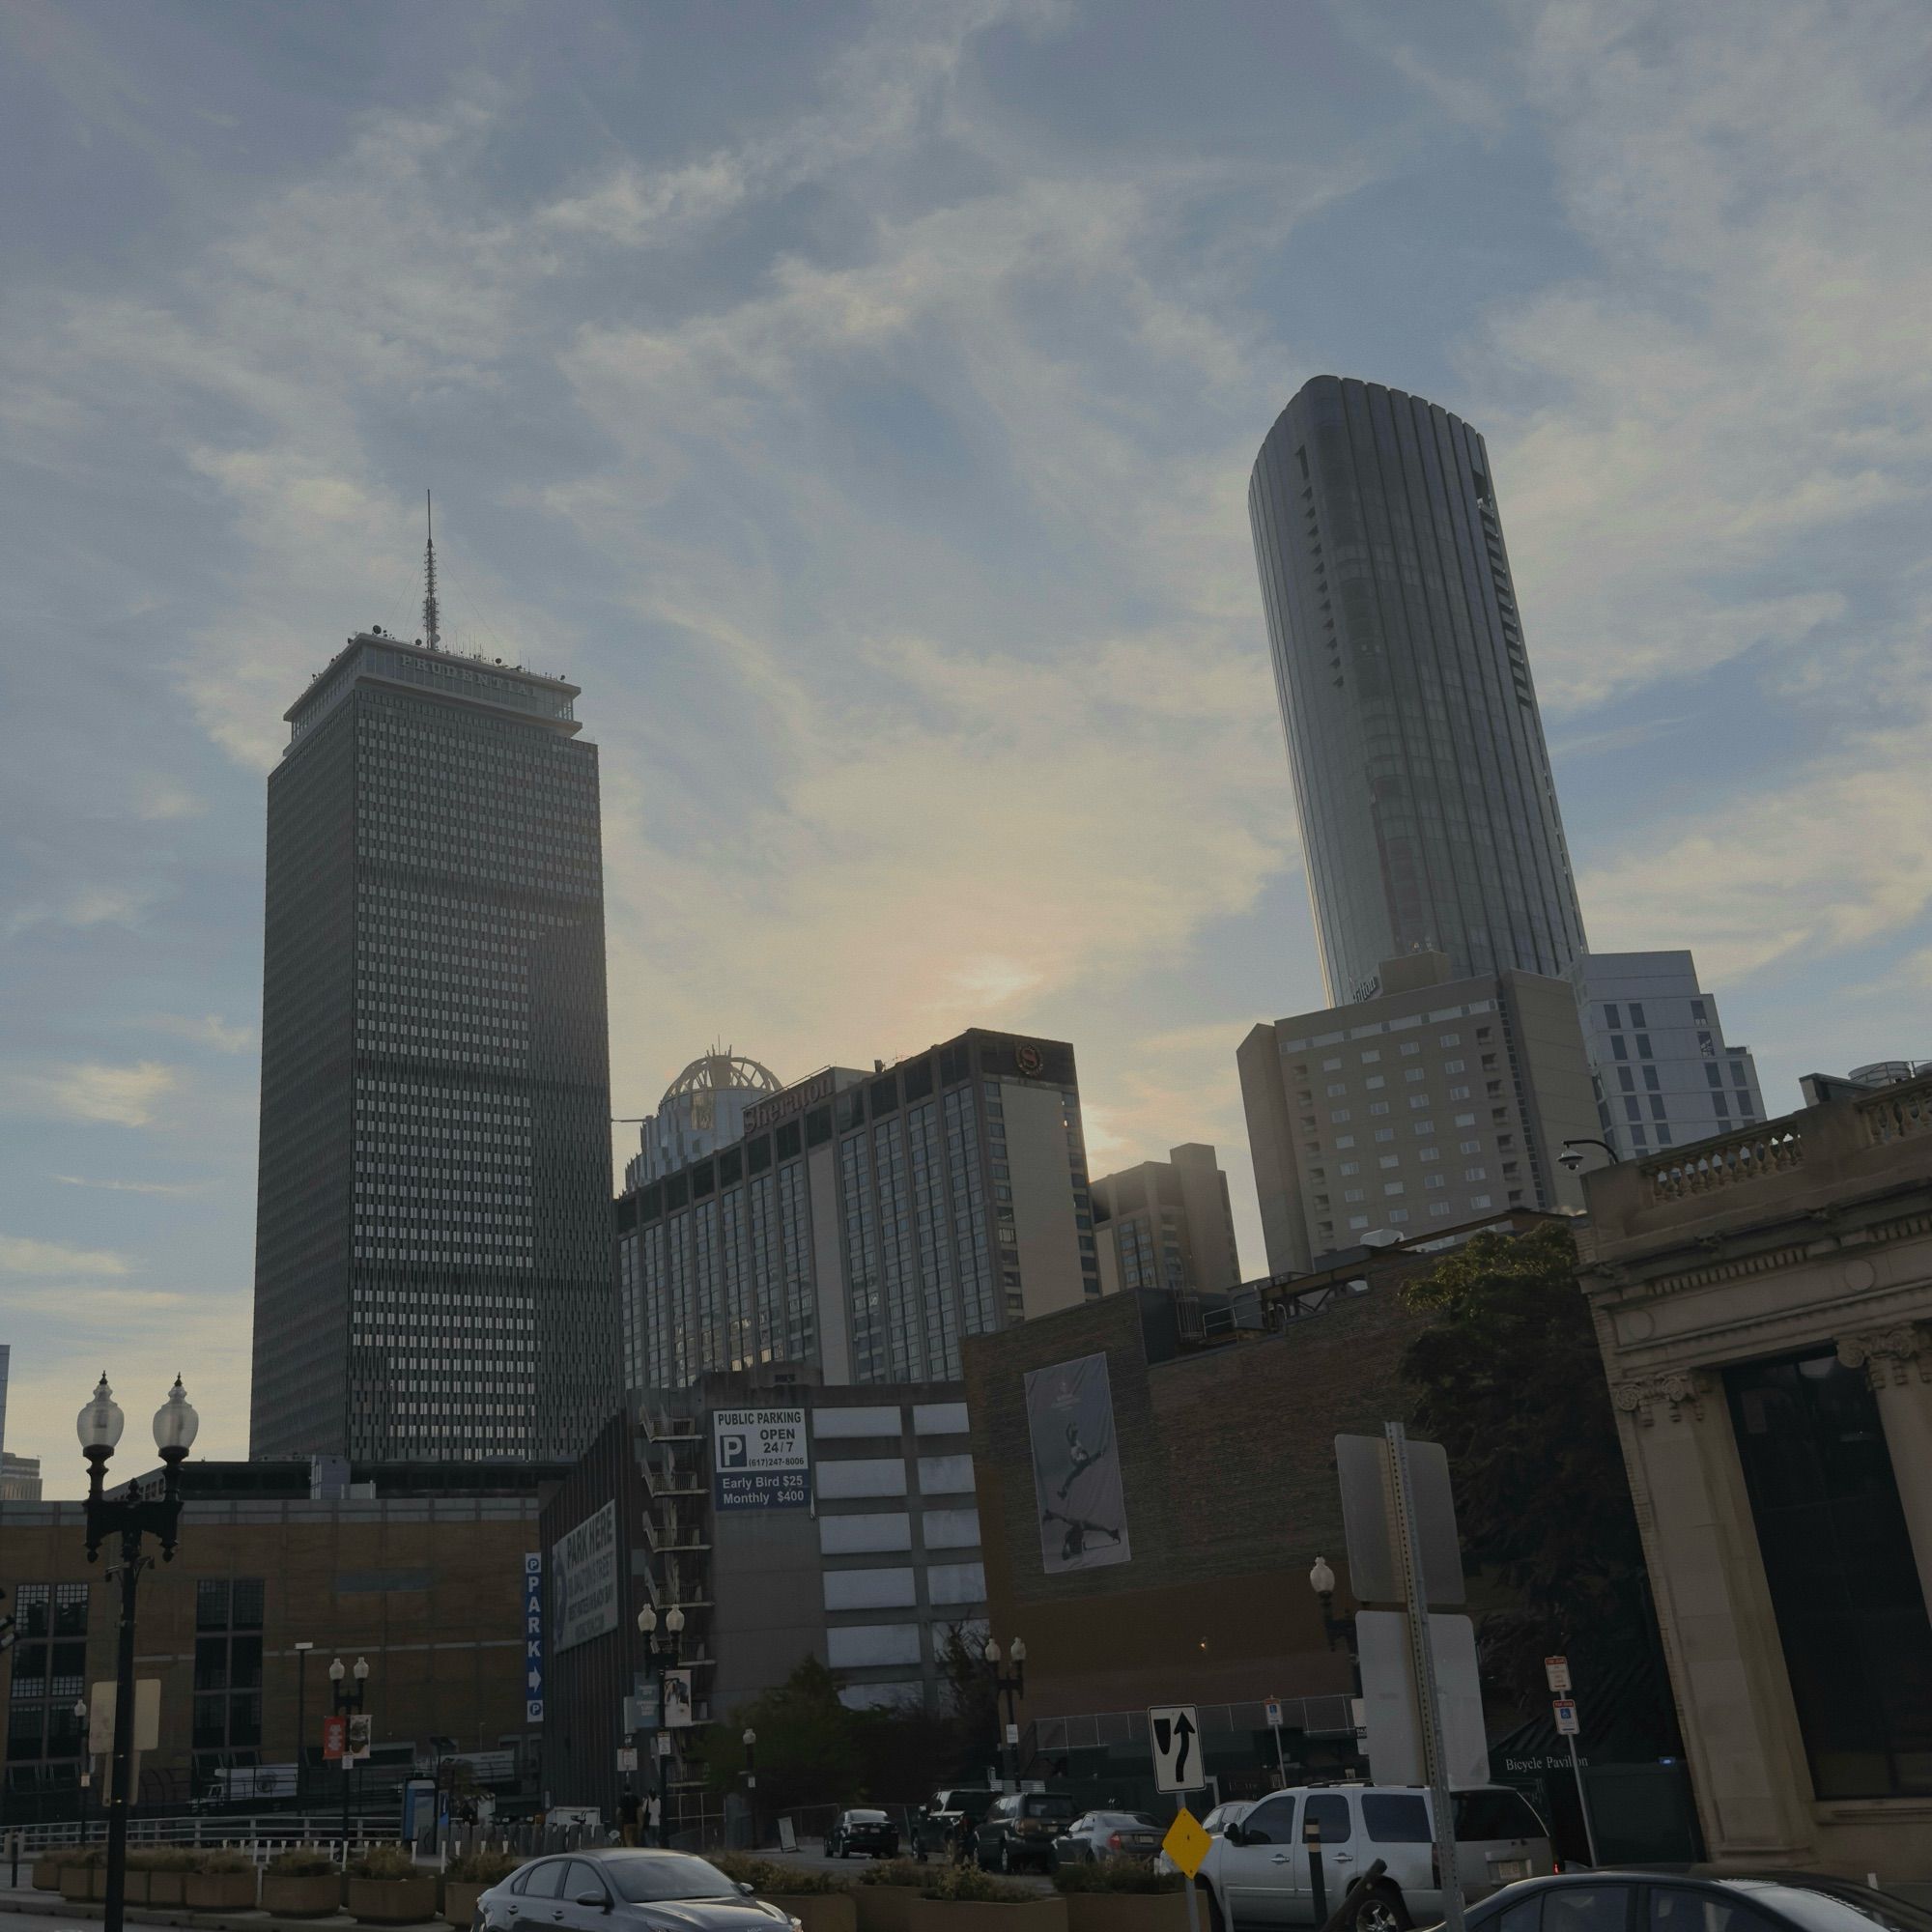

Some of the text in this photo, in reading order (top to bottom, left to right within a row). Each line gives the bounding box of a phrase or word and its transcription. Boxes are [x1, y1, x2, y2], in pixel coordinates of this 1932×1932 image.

[402, 656, 535, 696] PRUDENTIAL
[744, 1077, 835, 1133] Sheraton
[718, 1411, 802, 1426] PUBLIC PARKING
[759, 1429, 795, 1439] OPEN
[723, 1475, 803, 1491] Early Bird $25
[723, 1490, 804, 1505] Monthly $400
[567, 1507, 612, 1570] PARK HERE
[527, 1576, 541, 1658] PARK
[1505, 1754, 1590, 1774] Bicycle Pavilon
